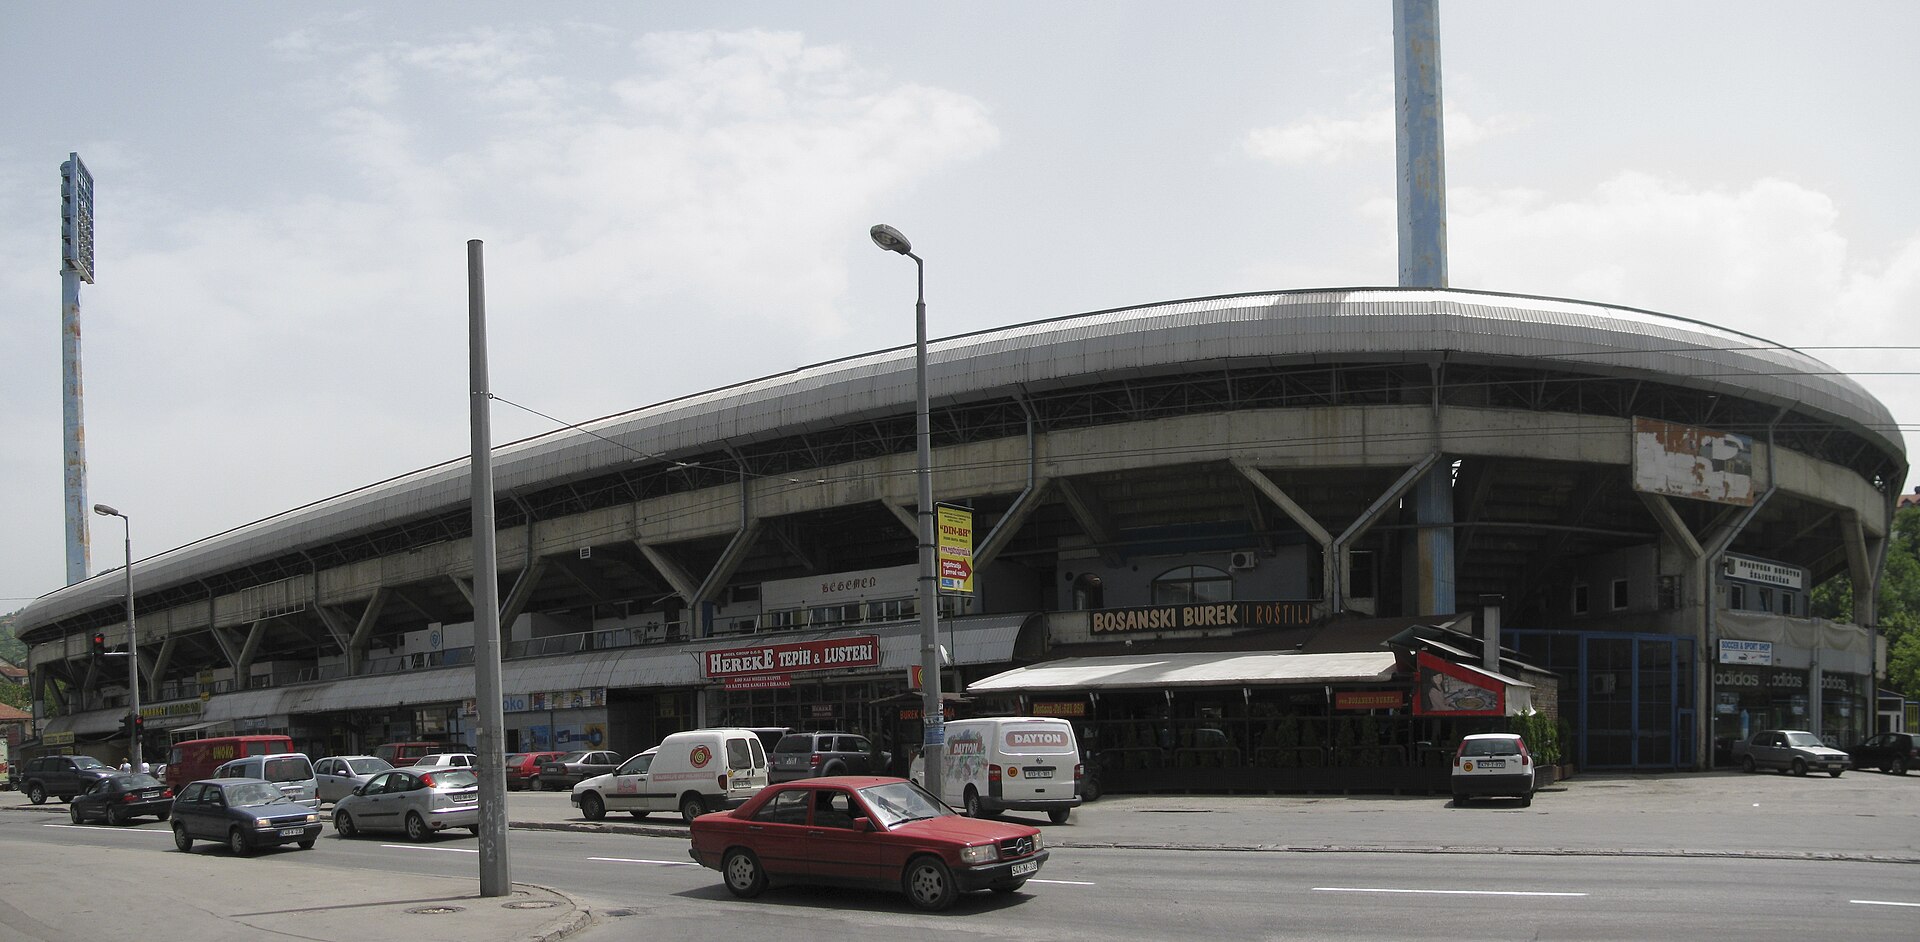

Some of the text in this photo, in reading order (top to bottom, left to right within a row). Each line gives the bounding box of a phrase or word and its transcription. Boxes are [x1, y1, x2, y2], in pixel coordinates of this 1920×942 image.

[1093, 608, 1177, 632] BOSANSKI
[1183, 604, 1238, 627] BUREK
[1256, 602, 1310, 624] ROŠTILJ
[710, 649, 774, 673] HEREKE
[814, 654, 820, 664] &
[1715, 671, 1759, 687] adidas
[1772, 673, 1802, 688] adidas
[900, 710, 918, 719] BUREK
[1014, 734, 1061, 744] DAYTON
[953, 743, 978, 754] DAYTON
